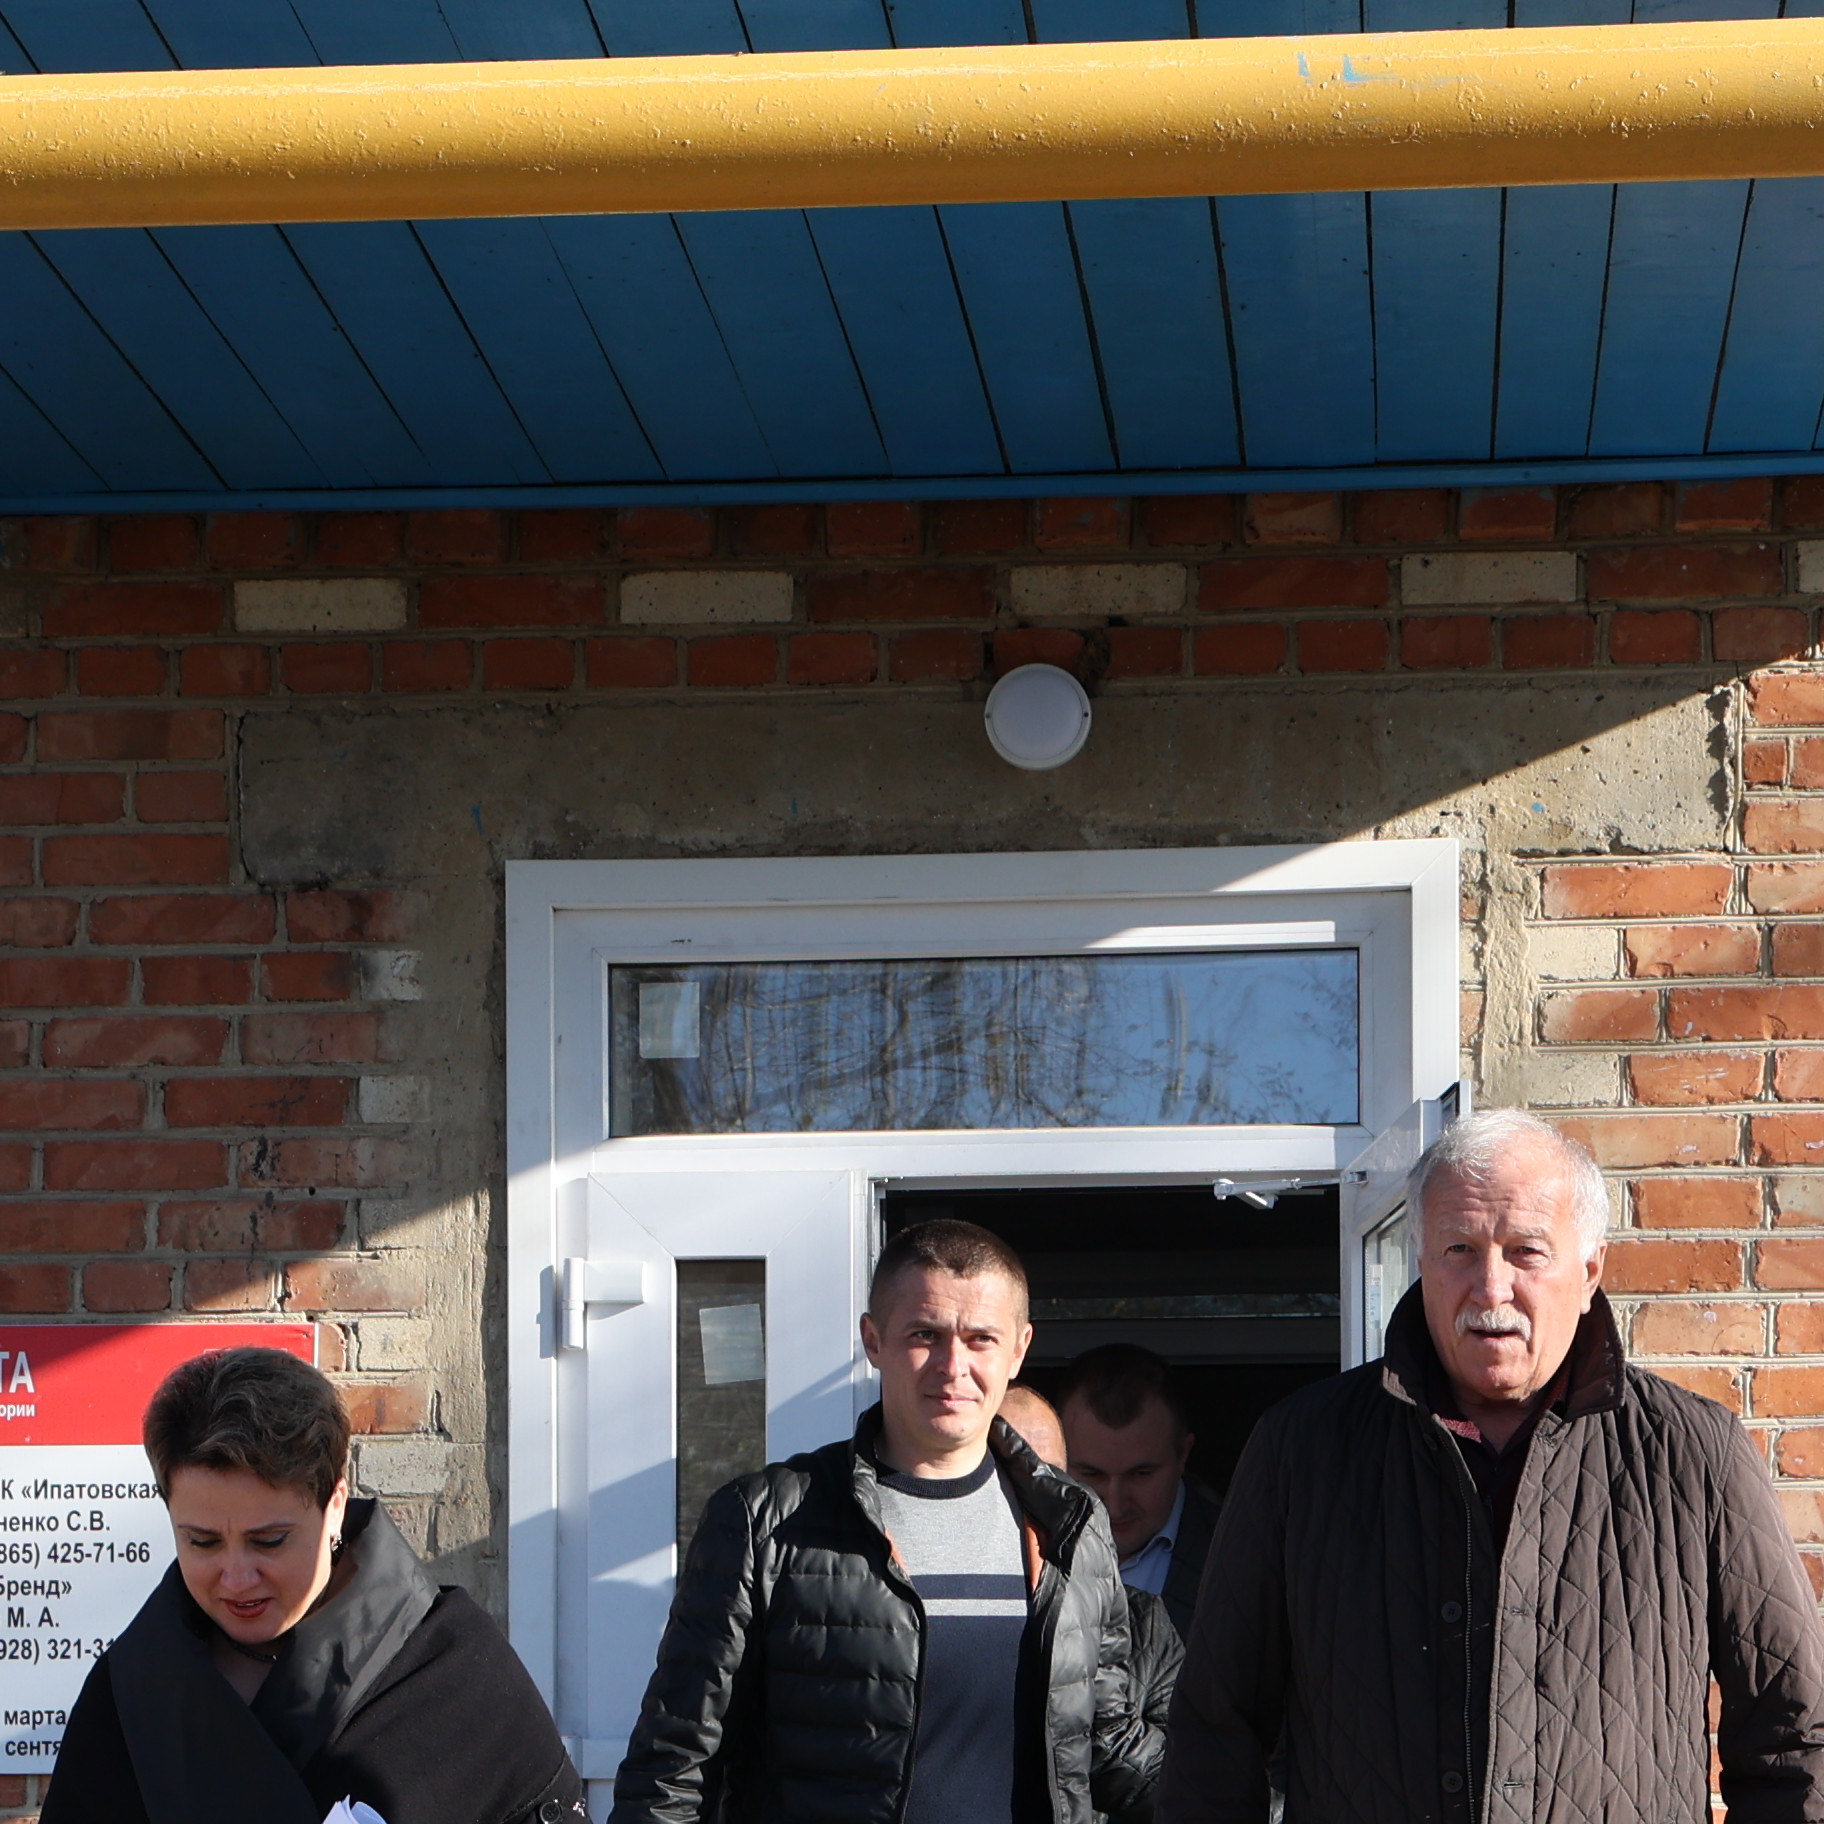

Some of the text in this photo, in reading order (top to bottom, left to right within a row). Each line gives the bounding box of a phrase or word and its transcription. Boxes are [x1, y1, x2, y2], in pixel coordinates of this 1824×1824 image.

[66, 1510, 111, 1532] С.В.
[46, 1541, 151, 1564] 425-71-66
[7, 1606, 31, 1628] М.
[37, 1606, 60, 1628] А.
[47, 1638, 114, 1660] 321-3
[4, 1709, 66, 1730] марта
